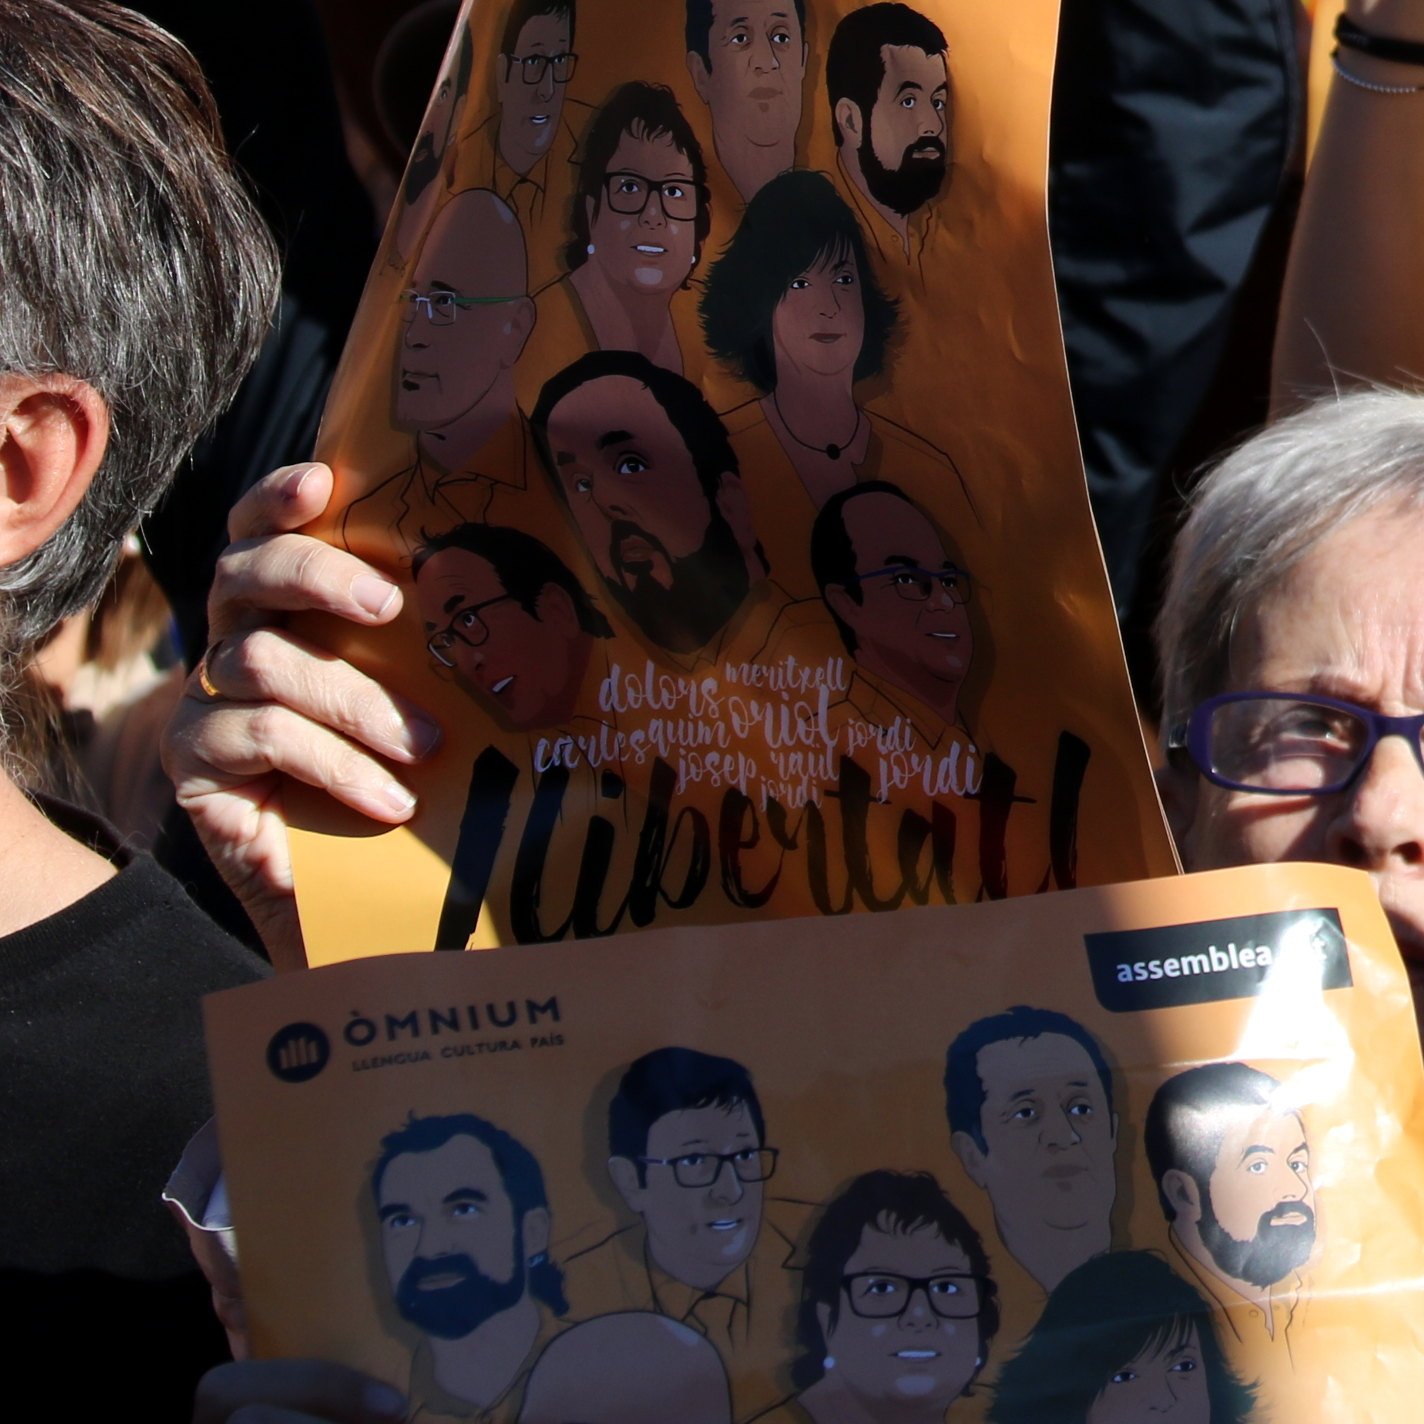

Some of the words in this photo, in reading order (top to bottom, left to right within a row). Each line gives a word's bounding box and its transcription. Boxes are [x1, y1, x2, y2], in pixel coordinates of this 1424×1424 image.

[600, 660, 725, 718] dolors
[724, 655, 846, 693] meritxell
[534, 721, 647, 773] carles
[648, 716, 732, 758] quim
[729, 684, 840, 748] oriol
[846, 717, 915, 754] jordi
[677, 748, 757, 795] josep
[877, 742, 983, 803] jordi
[760, 776, 823, 811] jordi
[343, 996, 561, 1047] ÒMNIUM
[352, 1050, 431, 1072] LLENGUA
[441, 1040, 521, 1059] CULTURA
